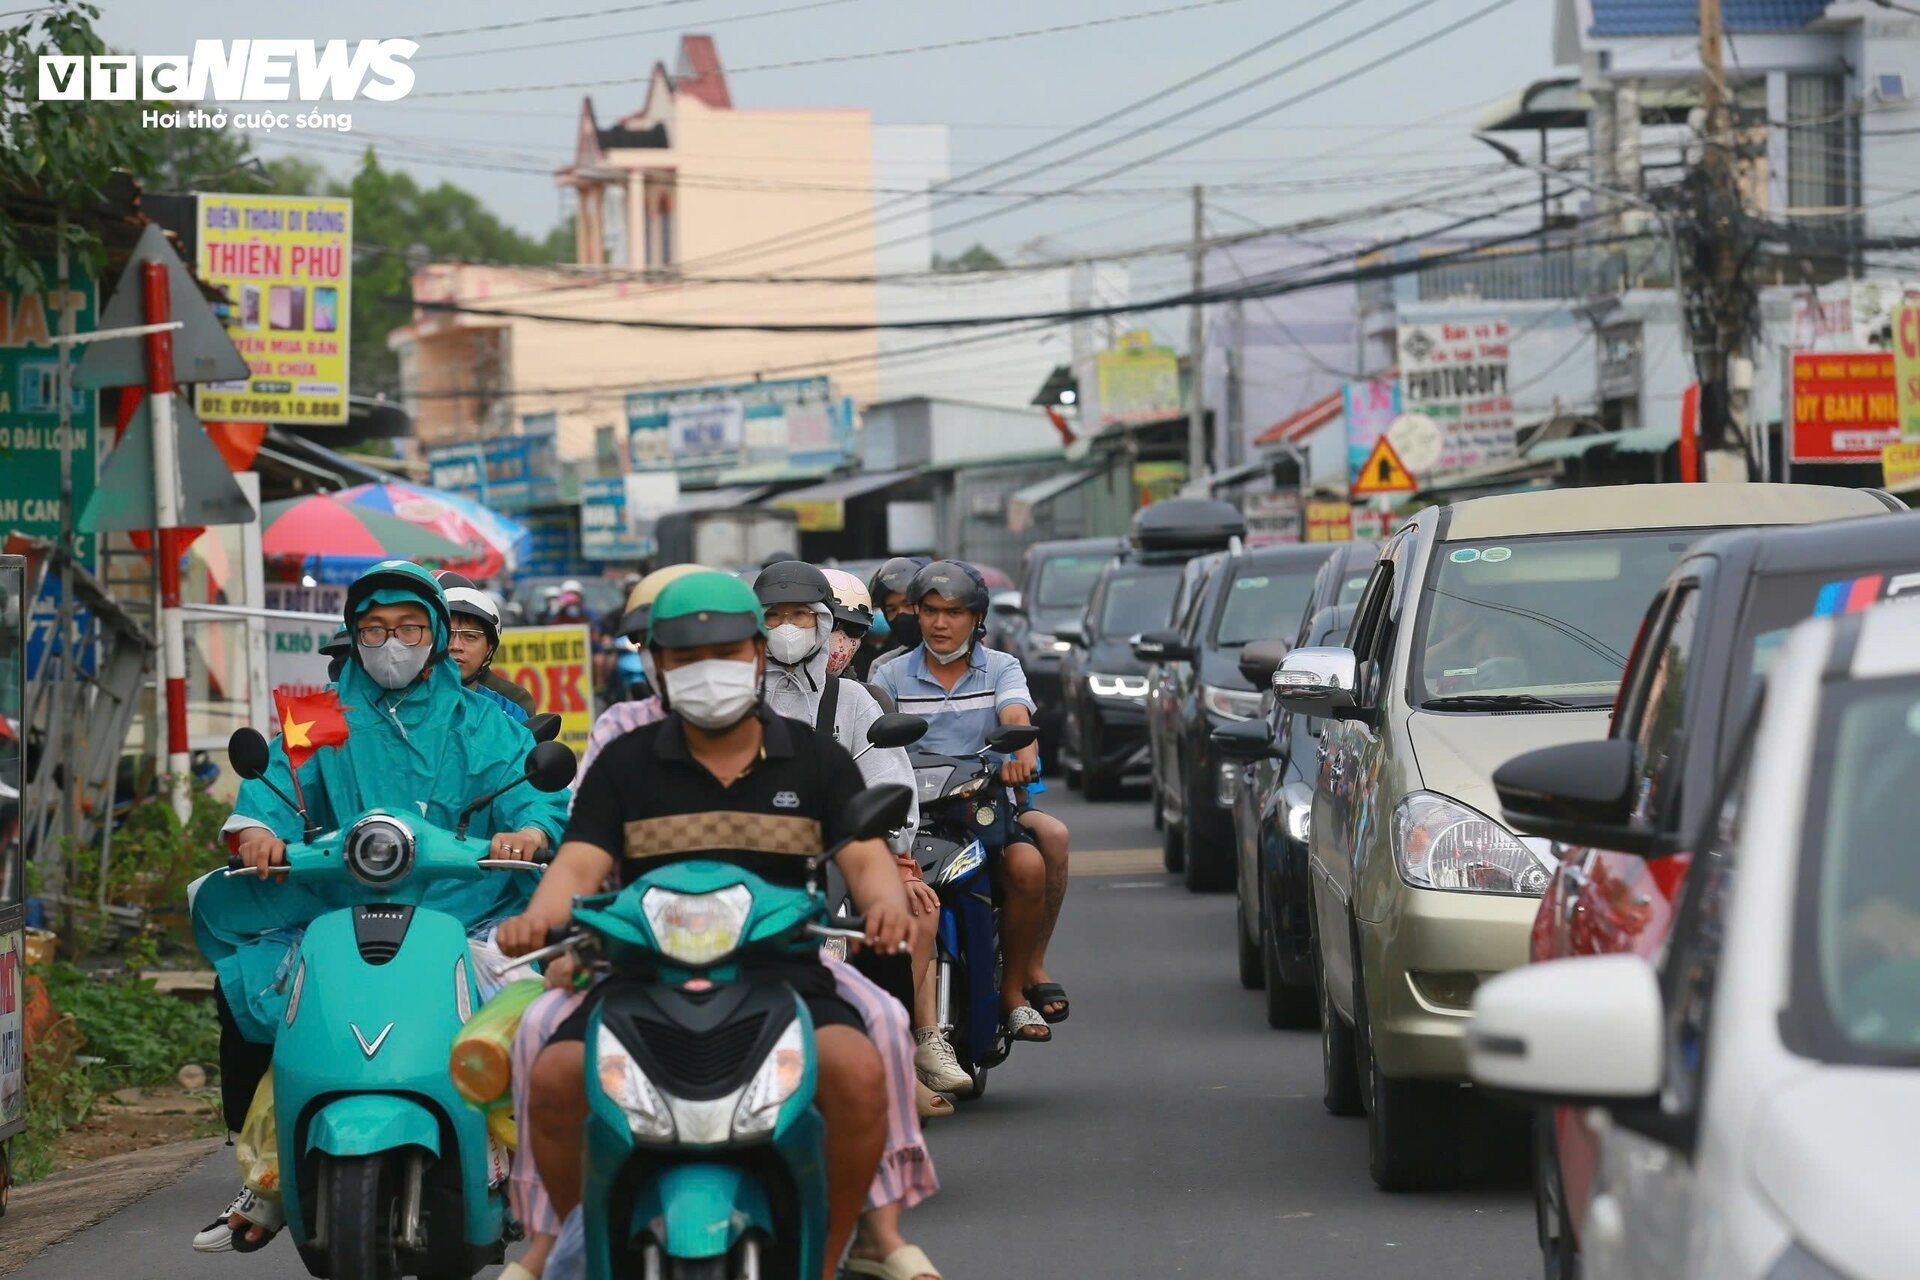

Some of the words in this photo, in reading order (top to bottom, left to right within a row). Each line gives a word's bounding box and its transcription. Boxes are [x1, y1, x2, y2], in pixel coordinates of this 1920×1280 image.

[206, 238, 282, 276] THIÊN
[1407, 364, 1508, 399] PHOTOCOPY
[1824, 392, 1864, 423] BAN
